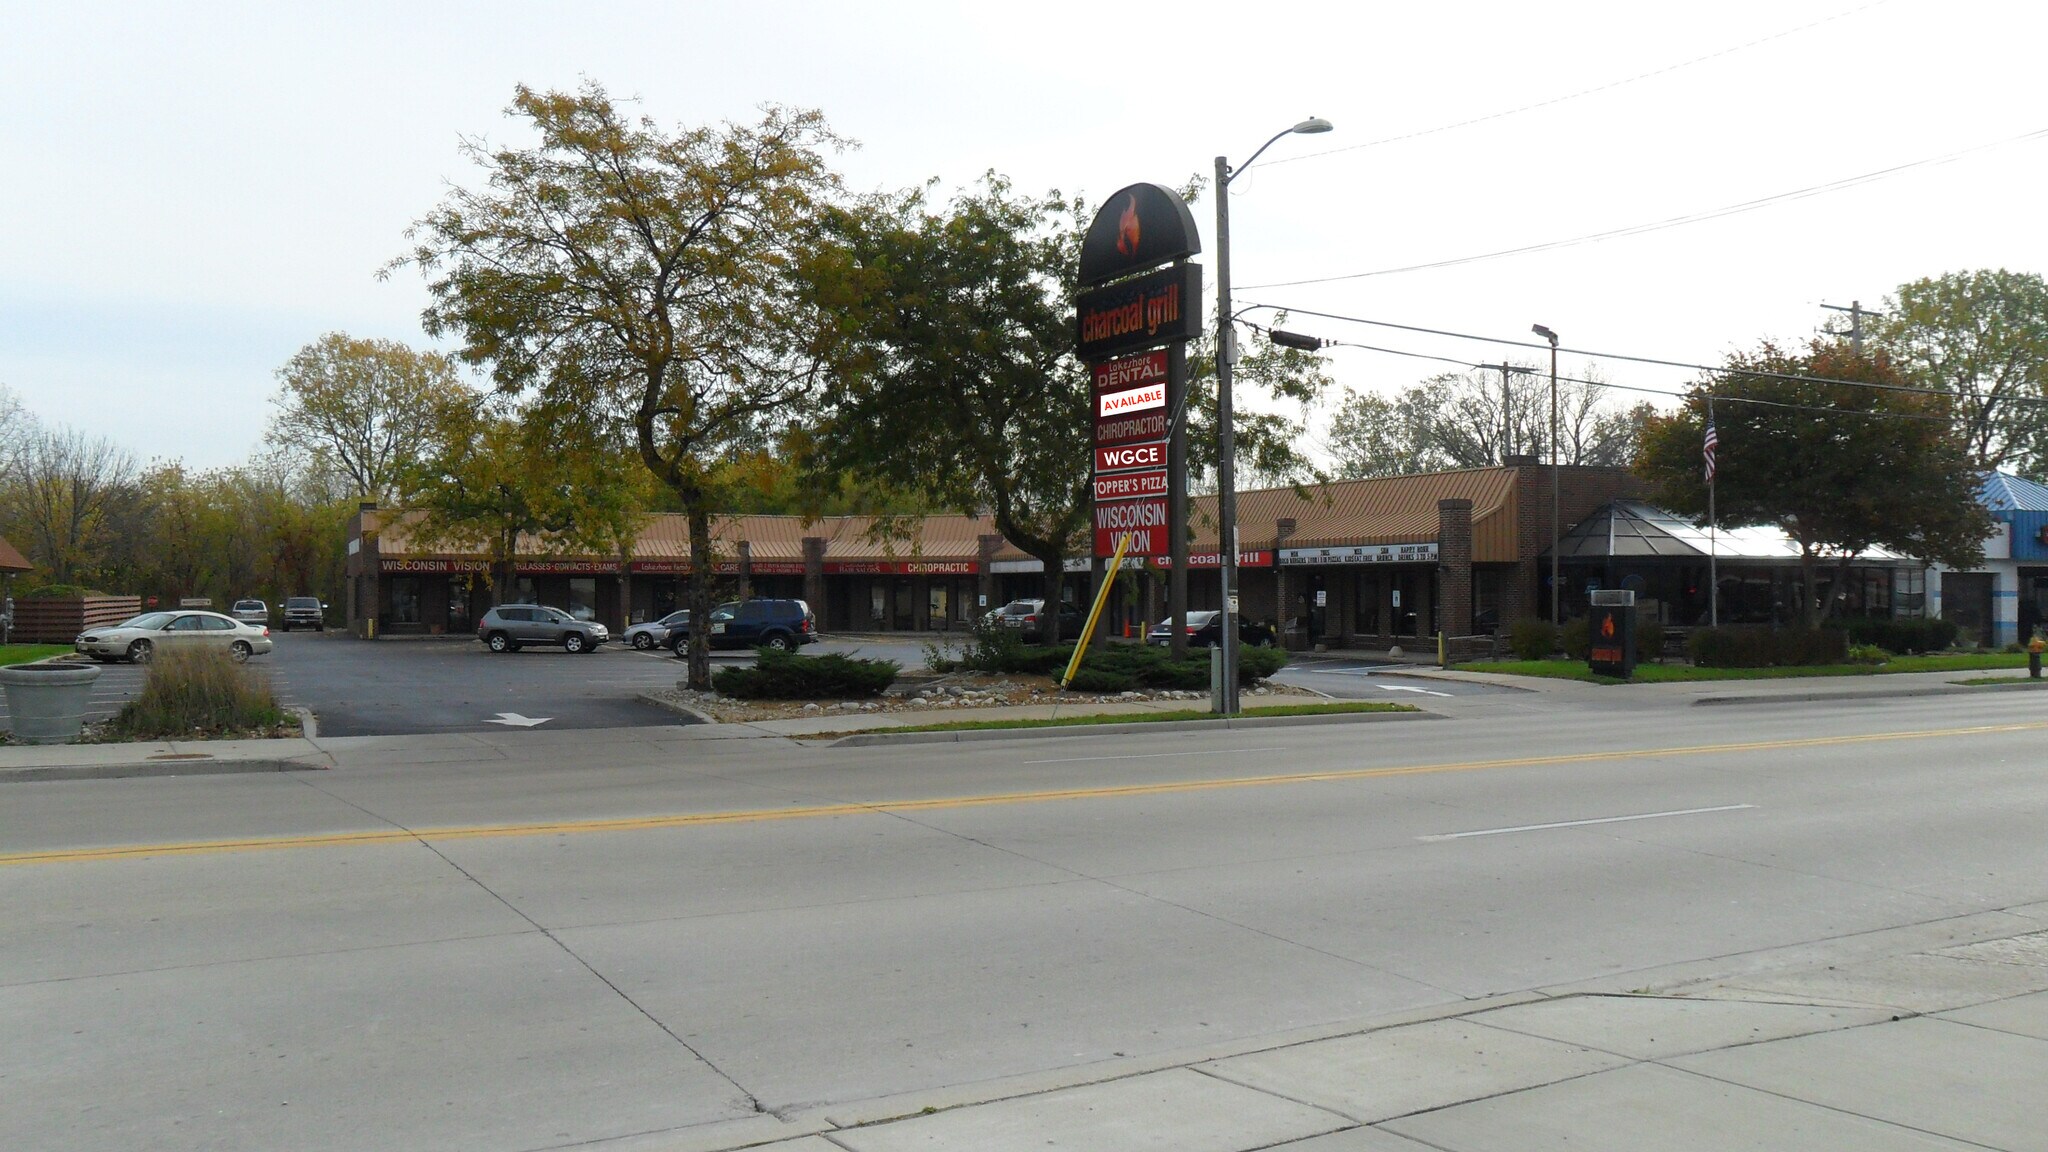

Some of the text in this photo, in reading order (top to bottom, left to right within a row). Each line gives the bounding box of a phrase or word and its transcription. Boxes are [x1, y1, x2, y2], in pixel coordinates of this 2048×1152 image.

[1082, 284, 1179, 344] charcoal grill
[1098, 362, 1165, 388] DENTAL
[1104, 390, 1163, 411] AVAILABLE
[1097, 415, 1165, 441] CHIROPRACTOR
[1103, 447, 1159, 466] WGCE
[1092, 476, 1169, 495] TOPPER'S PIZZA
[1096, 503, 1166, 529] WISCONSIN
[382, 560, 490, 571] WISCONSIN VISION
[594, 562, 618, 571] EXAMS
[720, 563, 740, 571] CARE
[907, 562, 969, 573] CHIROPRACTIC
